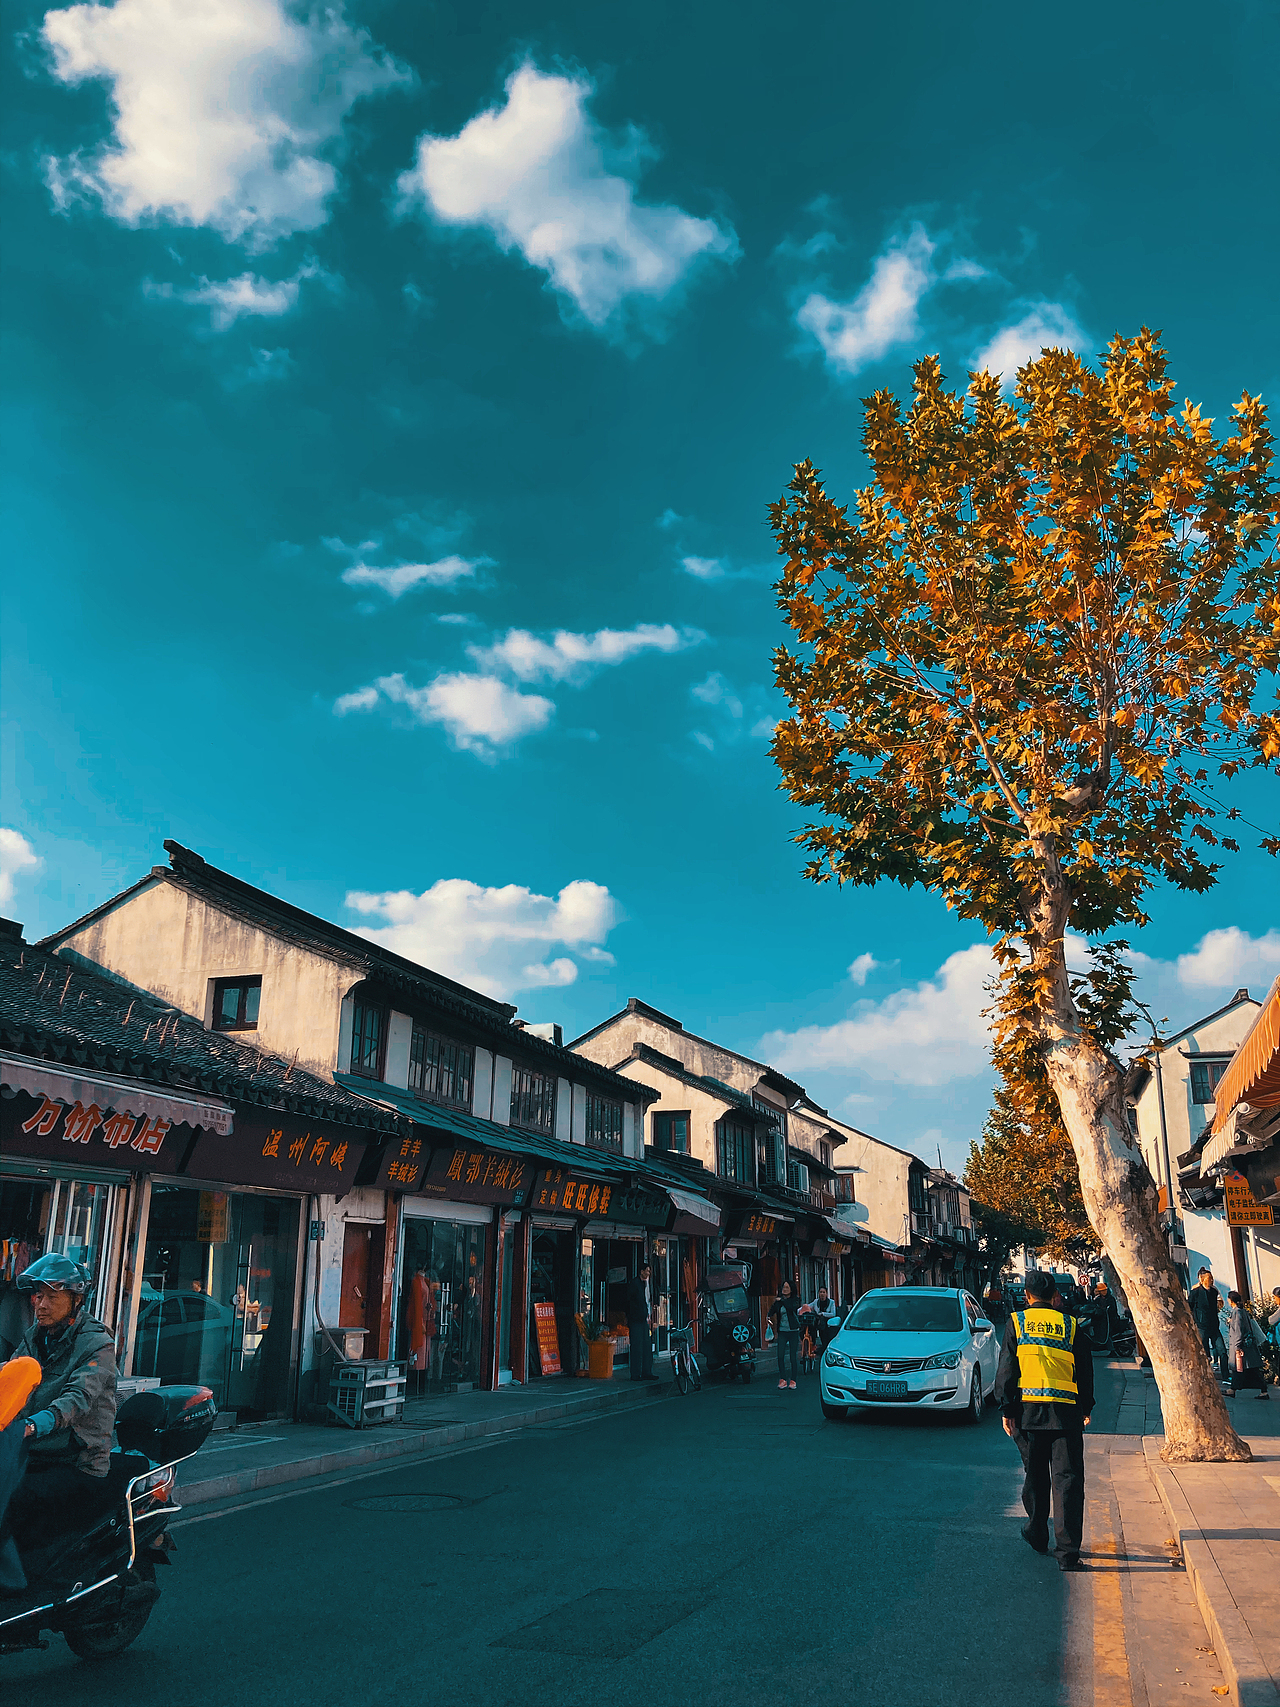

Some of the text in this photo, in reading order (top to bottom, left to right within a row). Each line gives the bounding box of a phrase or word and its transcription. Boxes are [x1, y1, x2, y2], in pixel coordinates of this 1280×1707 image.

[262, 1128, 348, 1171] 温州阿姨
[1027, 1321, 1063, 1336] 综合协勤
